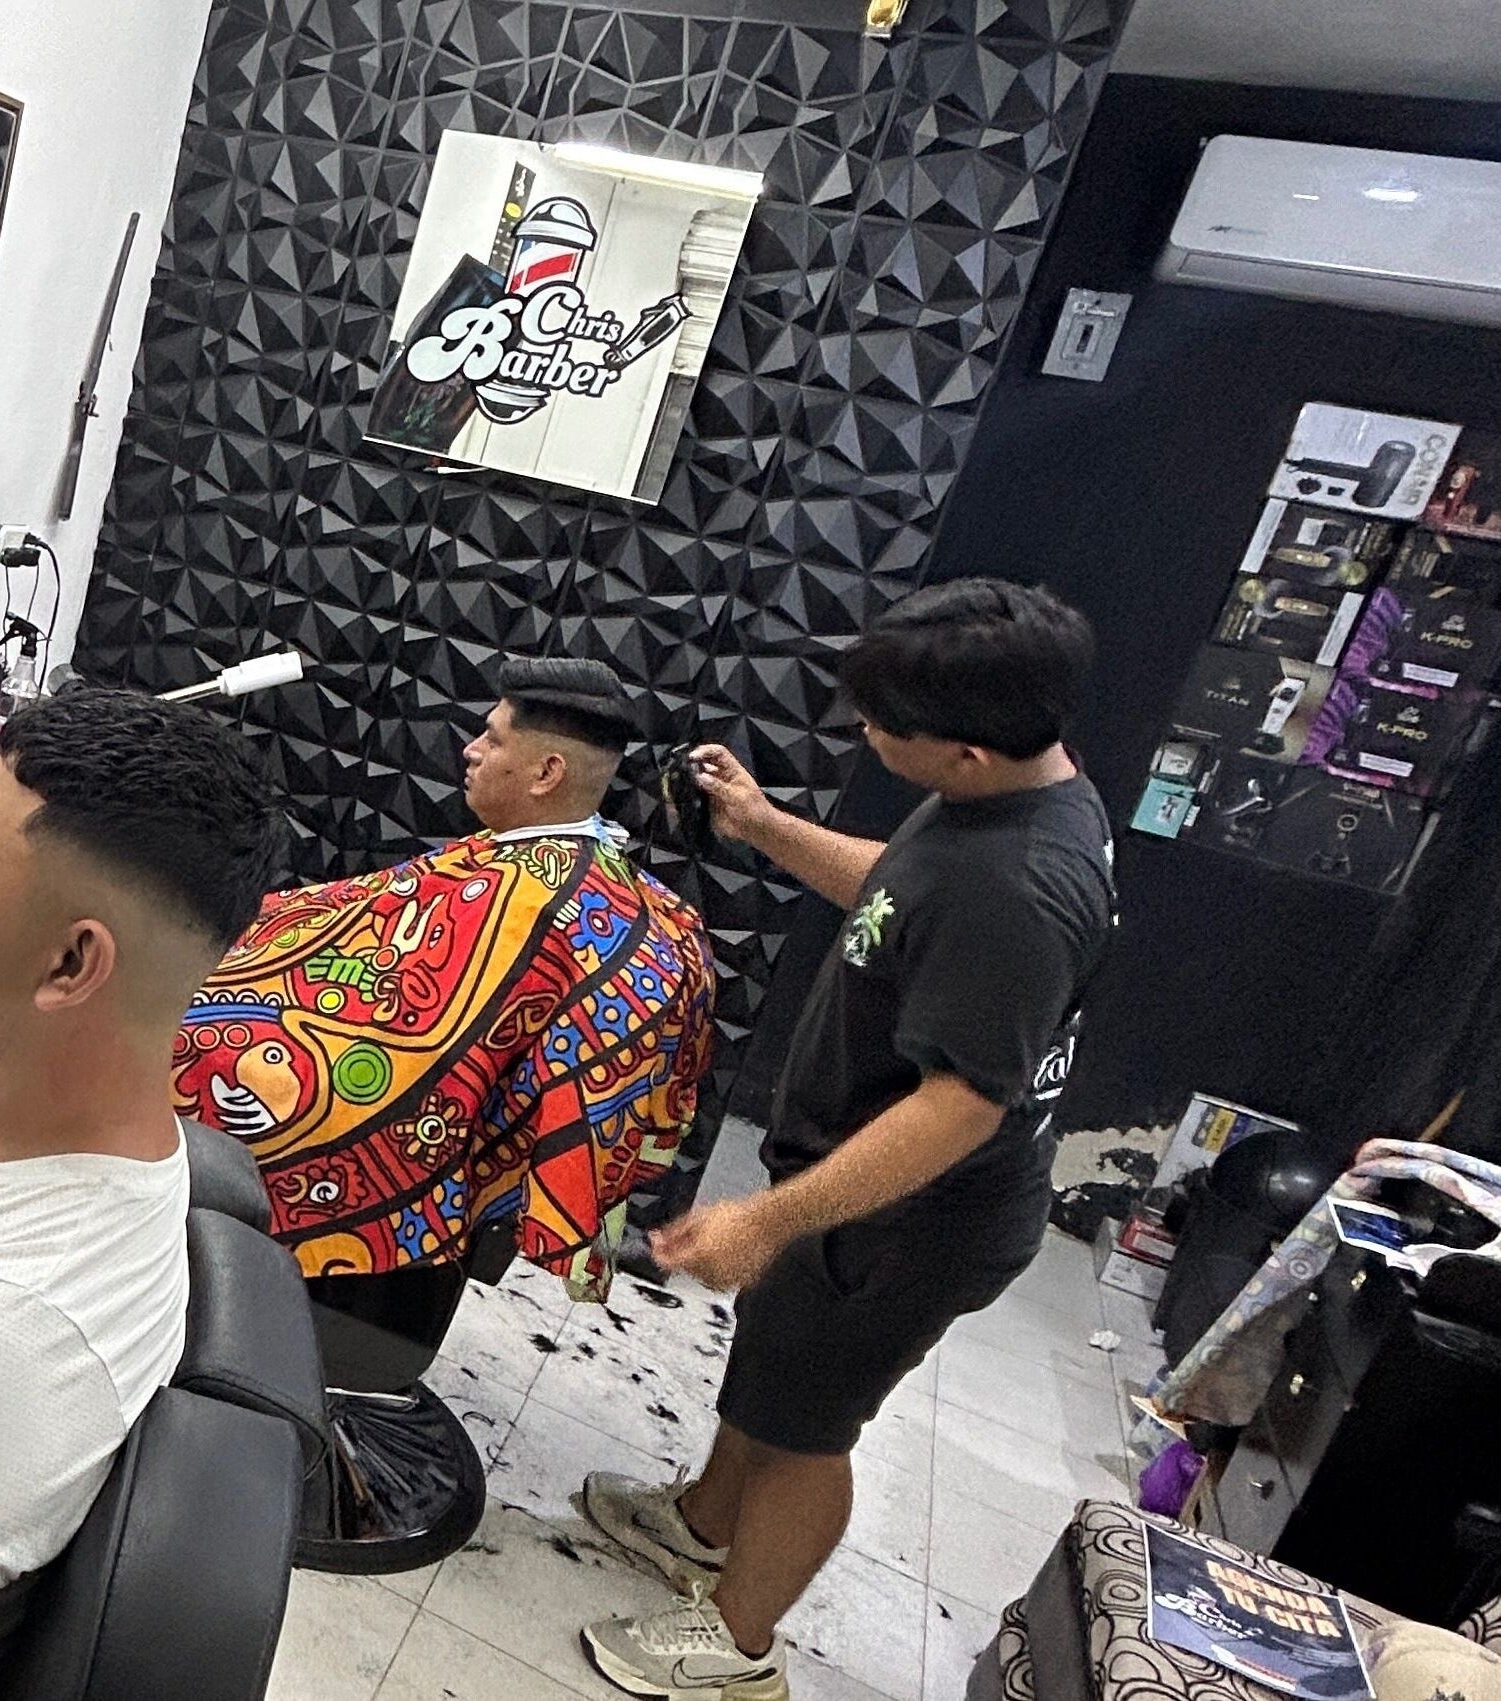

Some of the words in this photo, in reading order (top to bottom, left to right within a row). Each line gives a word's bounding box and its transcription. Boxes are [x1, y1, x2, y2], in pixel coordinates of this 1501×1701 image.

[519, 282, 625, 343] Chris
[406, 298, 619, 397] Barber
[1420, 631, 1473, 649] K-PRO
[1376, 721, 1428, 741] K-PRO
[1205, 1559, 1332, 1616] AGENDA
[1214, 1581, 1259, 1615] TU
[1264, 1603, 1342, 1638] CITA
